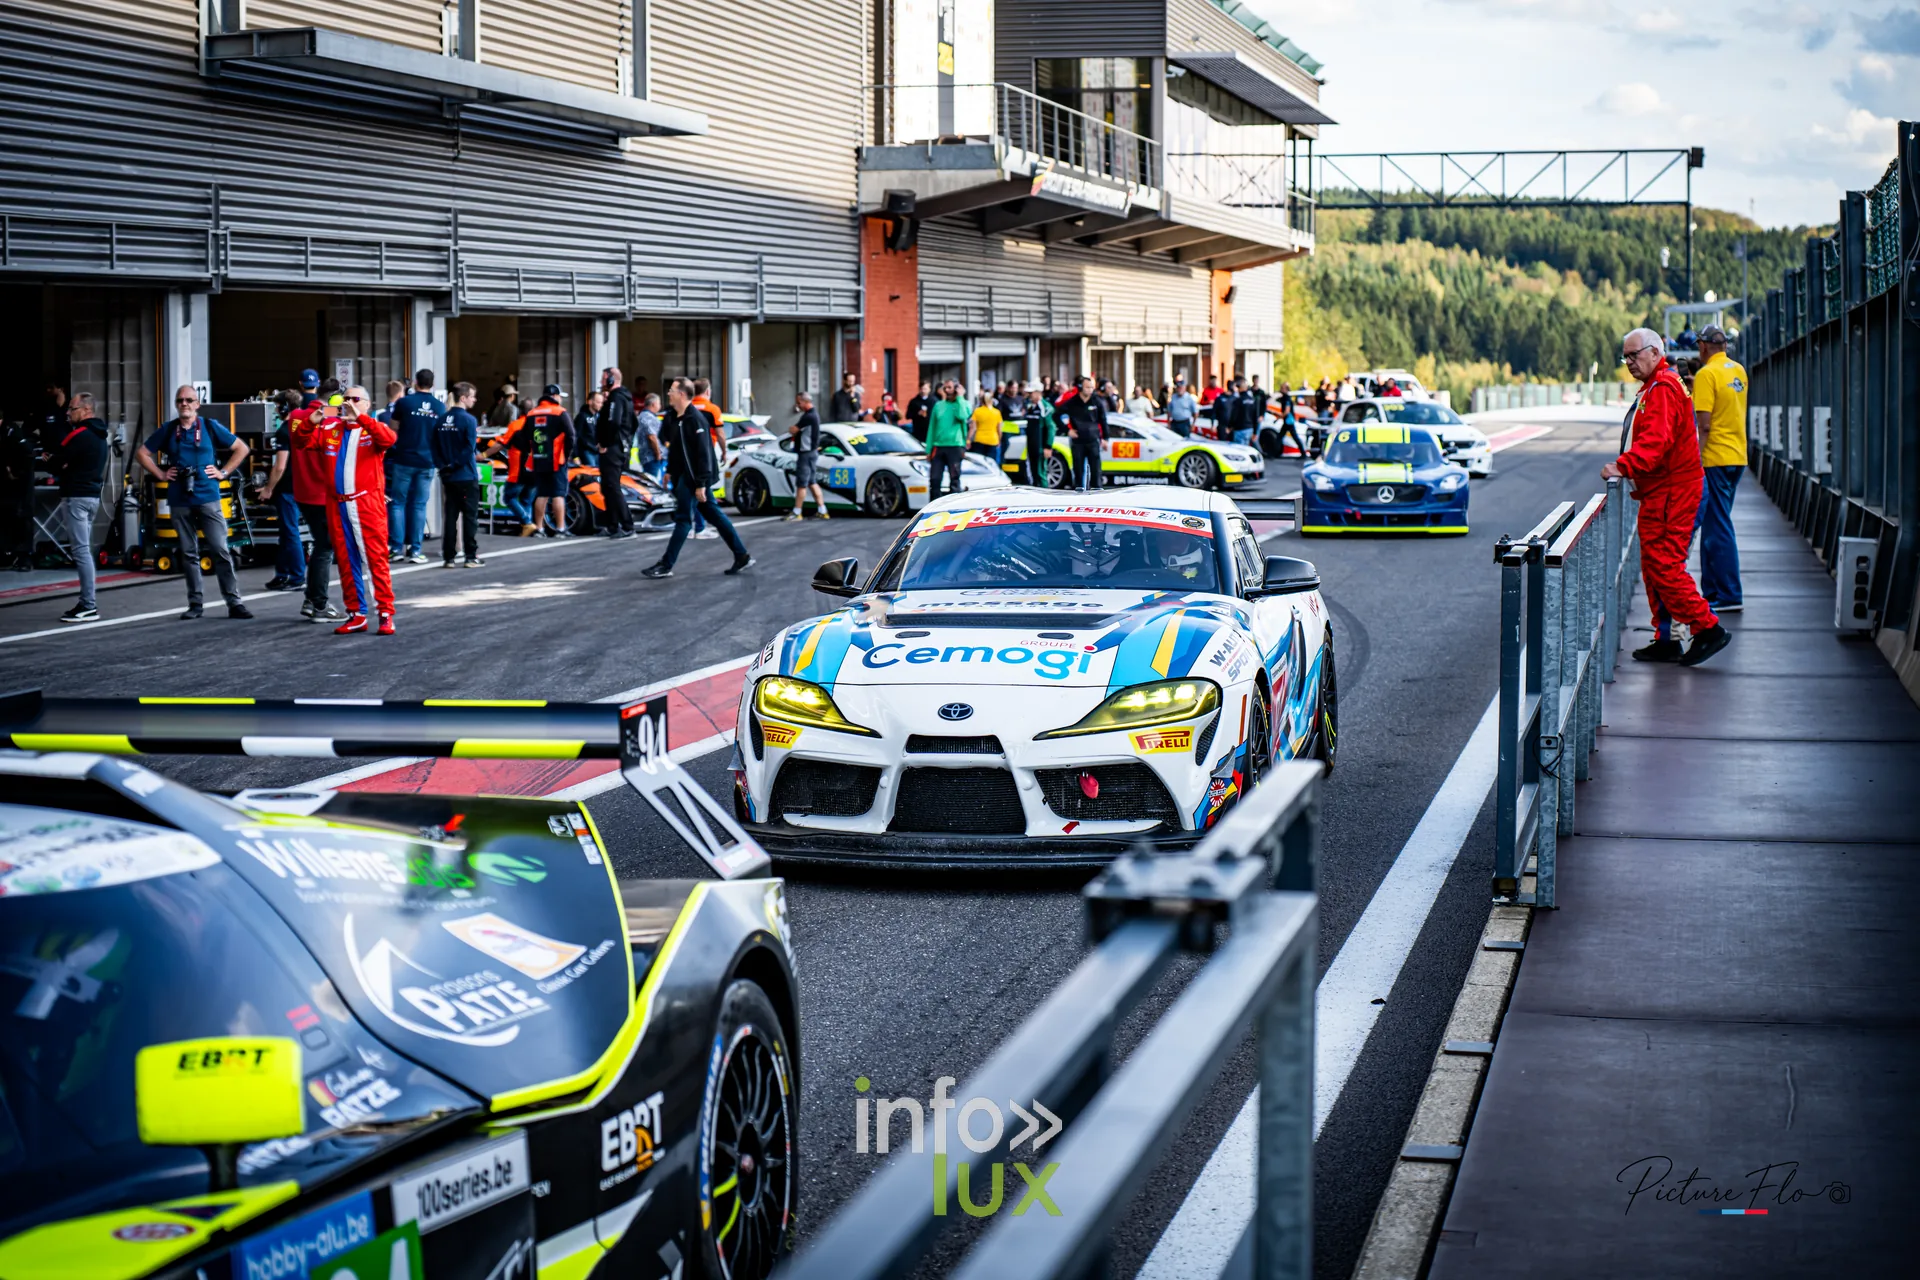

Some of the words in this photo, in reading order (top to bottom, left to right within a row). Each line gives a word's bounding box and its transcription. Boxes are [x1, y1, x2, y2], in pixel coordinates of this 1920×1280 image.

[1118, 445, 1134, 457] 50
[834, 469, 849, 485] 58
[916, 509, 977, 538] 91
[993, 507, 1065, 516] assurances
[1065, 505, 1150, 518] LESTIENNE
[1019, 639, 1077, 649] GROUPE
[861, 643, 1099, 680] Cemogi
[1135, 730, 1190, 750] PIRELLI
[235, 837, 407, 884] Willems
[399, 980, 544, 1034] PATZE
[416, 1155, 513, 1220] 100series.be
[245, 1213, 369, 1280] hobby-alu.be
